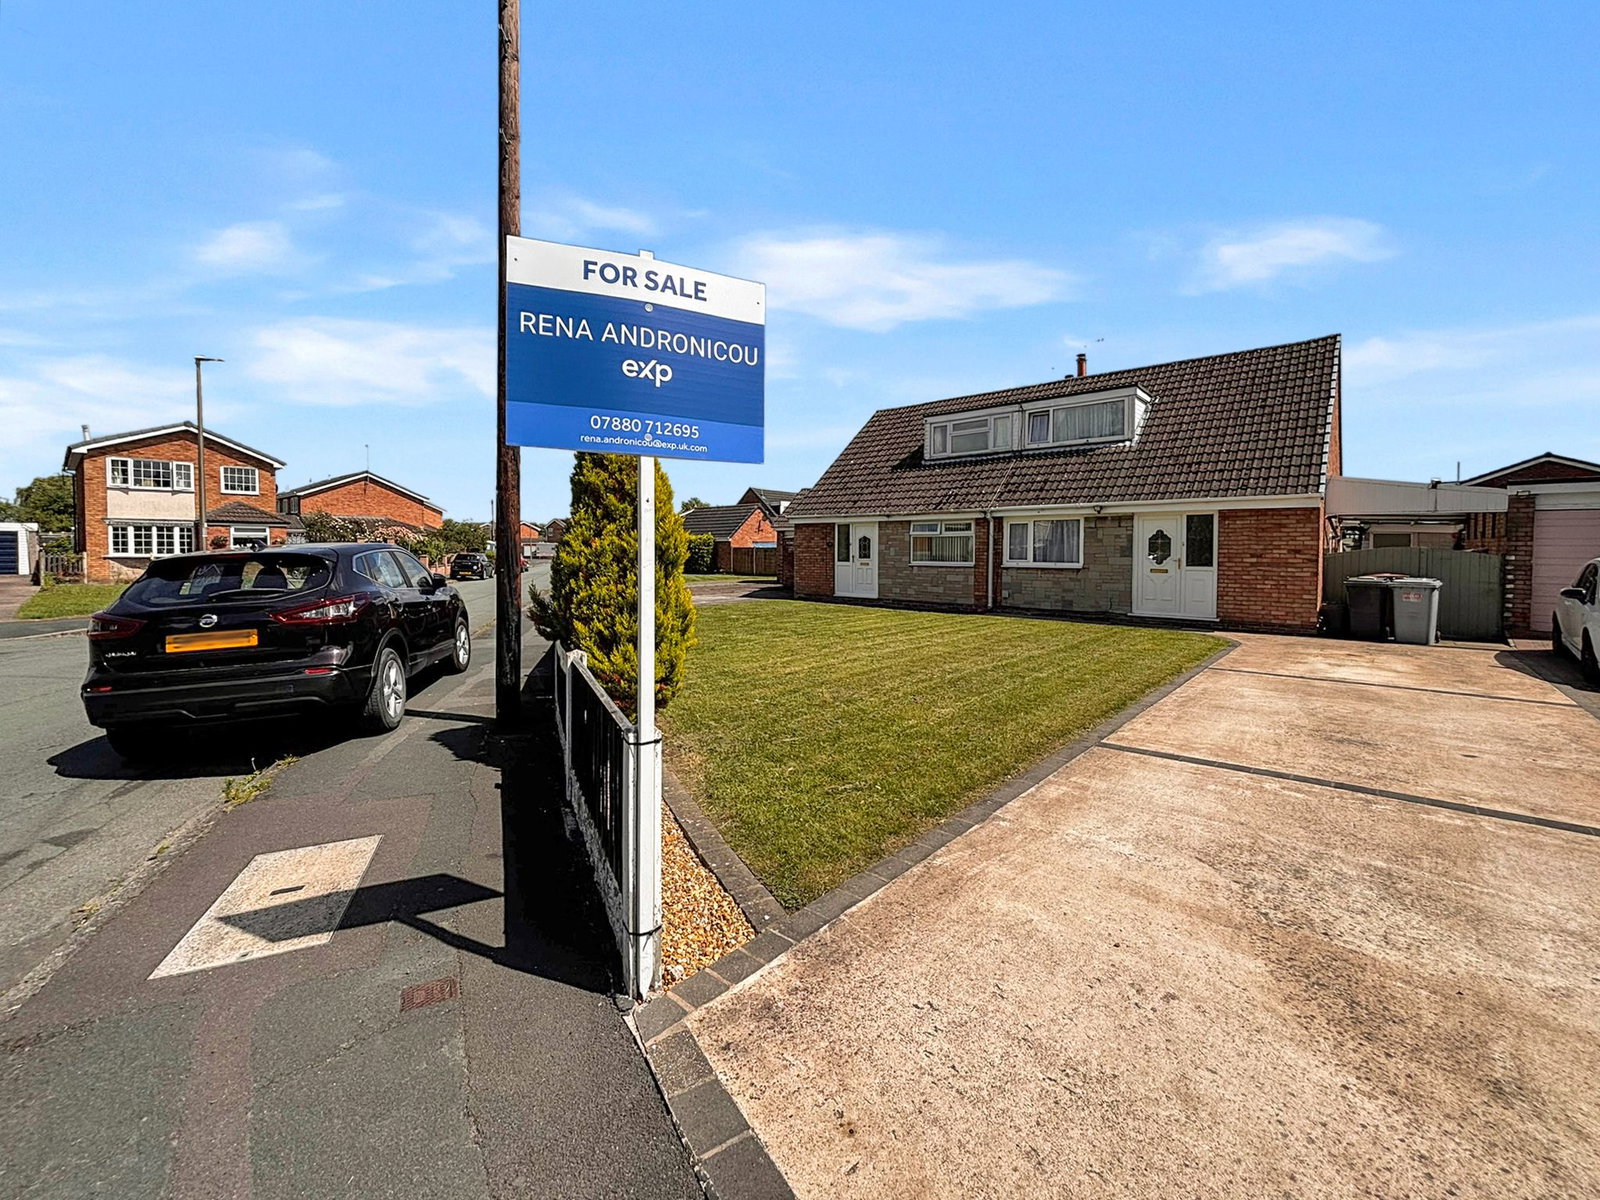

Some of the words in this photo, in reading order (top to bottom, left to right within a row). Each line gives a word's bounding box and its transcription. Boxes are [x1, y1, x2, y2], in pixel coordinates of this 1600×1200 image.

[582, 259, 638, 288] FOR
[644, 270, 708, 302] SALE
[519, 311, 594, 341] RENA
[601, 322, 759, 366] ANDRONICOU
[621, 359, 673, 388] exp
[590, 415, 642, 433] 07880
[644, 420, 700, 439] 712695
[580, 434, 708, 453] rena.andronicou@exp.uk.com
